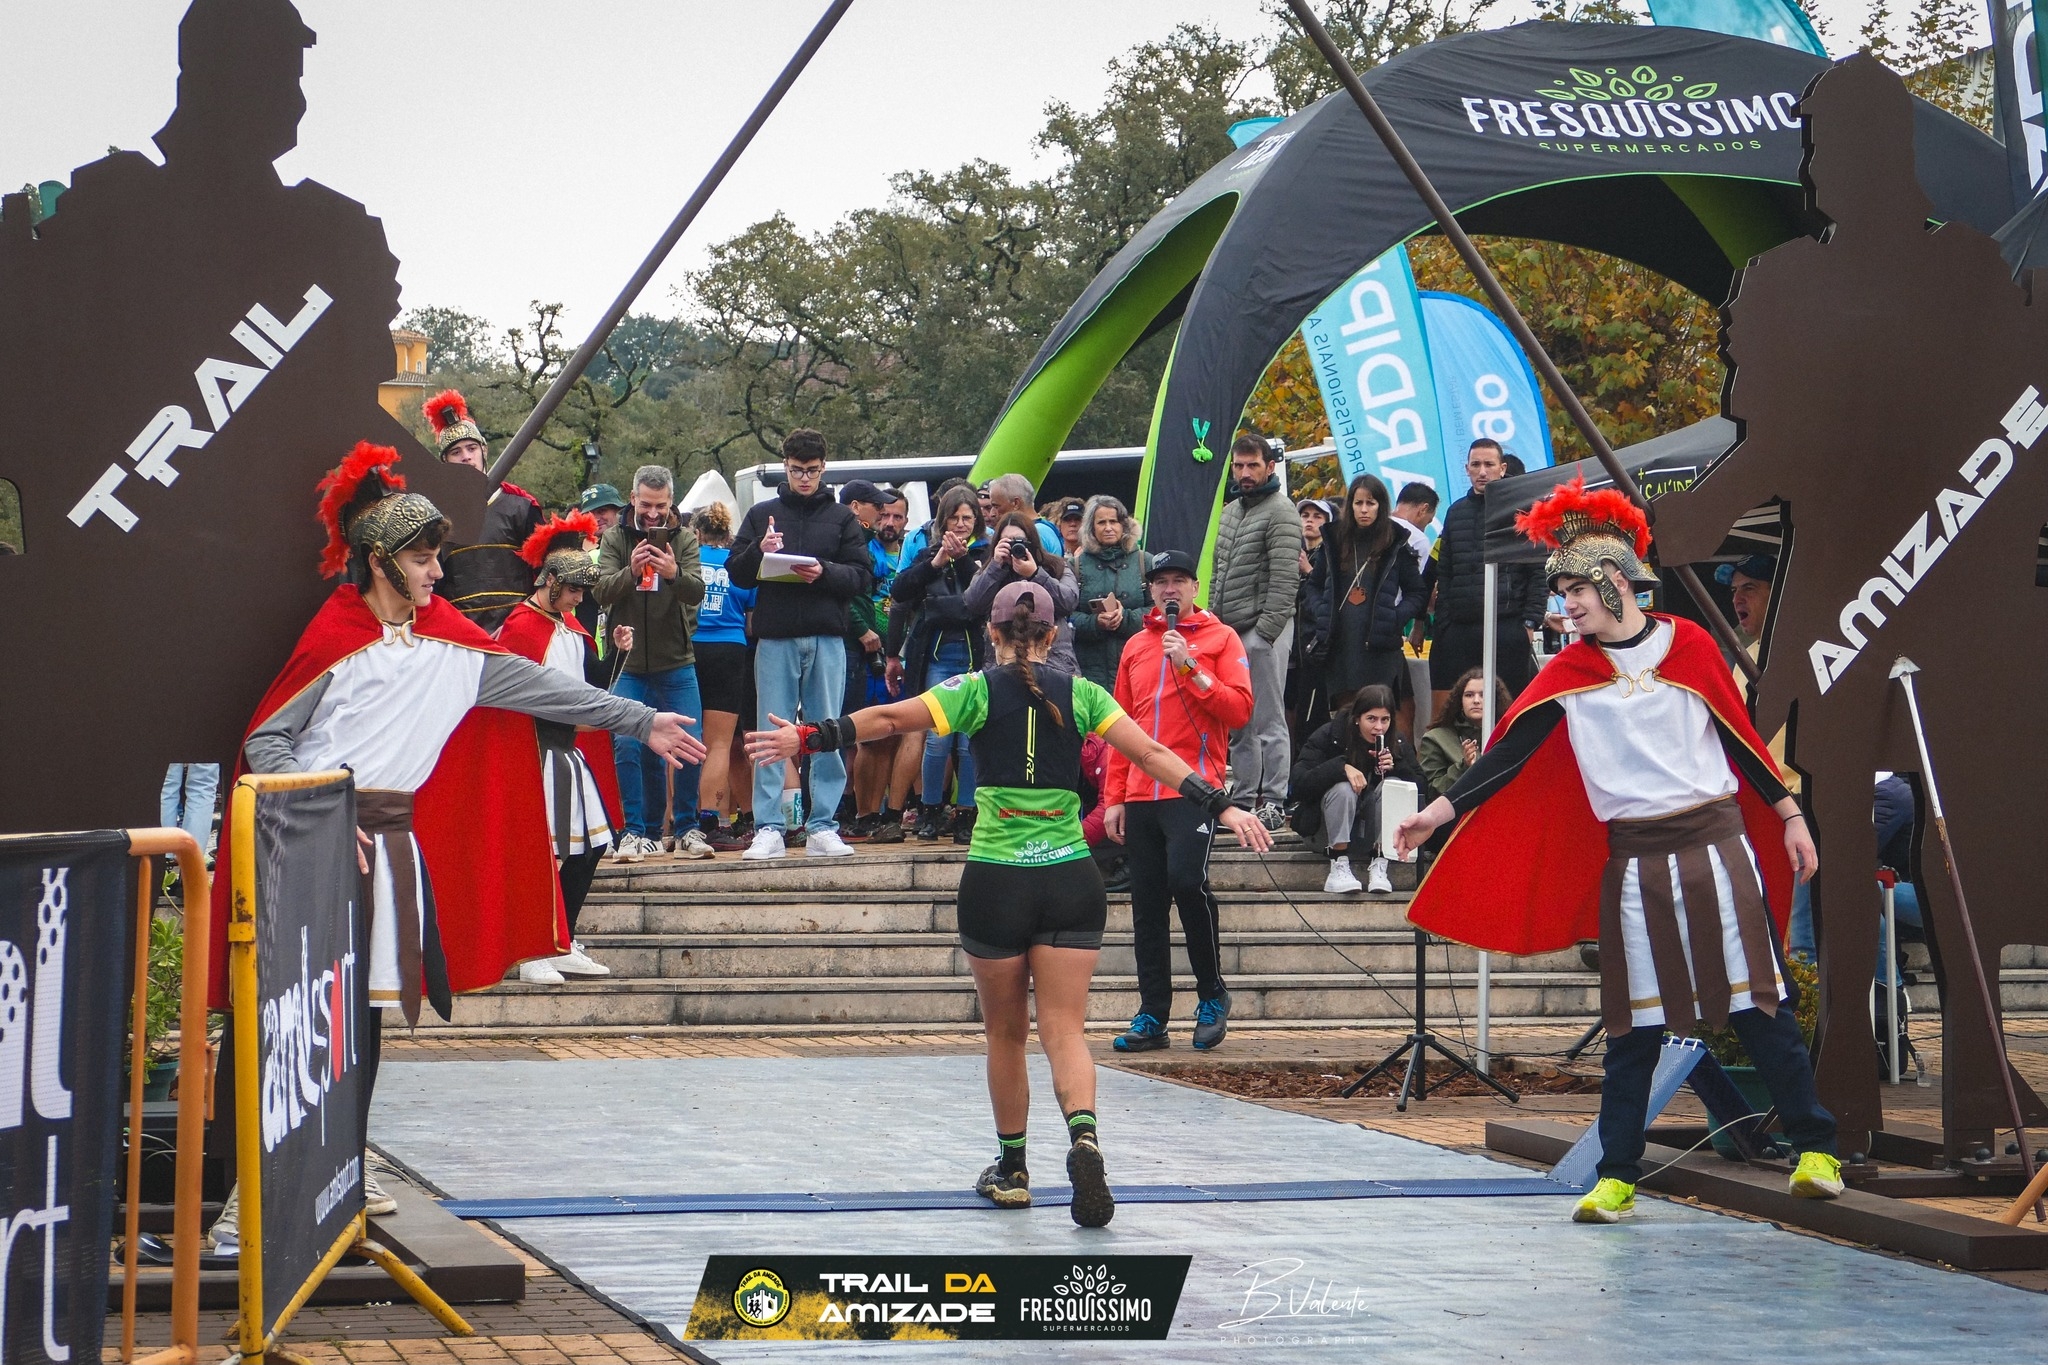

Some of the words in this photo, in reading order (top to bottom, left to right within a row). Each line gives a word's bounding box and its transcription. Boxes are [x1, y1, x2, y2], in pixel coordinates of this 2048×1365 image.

[1538, 140, 1762, 154] SUPERMERCADOS
[66, 283, 334, 532] TRAIL
[1808, 384, 2048, 696] AMIZADE
